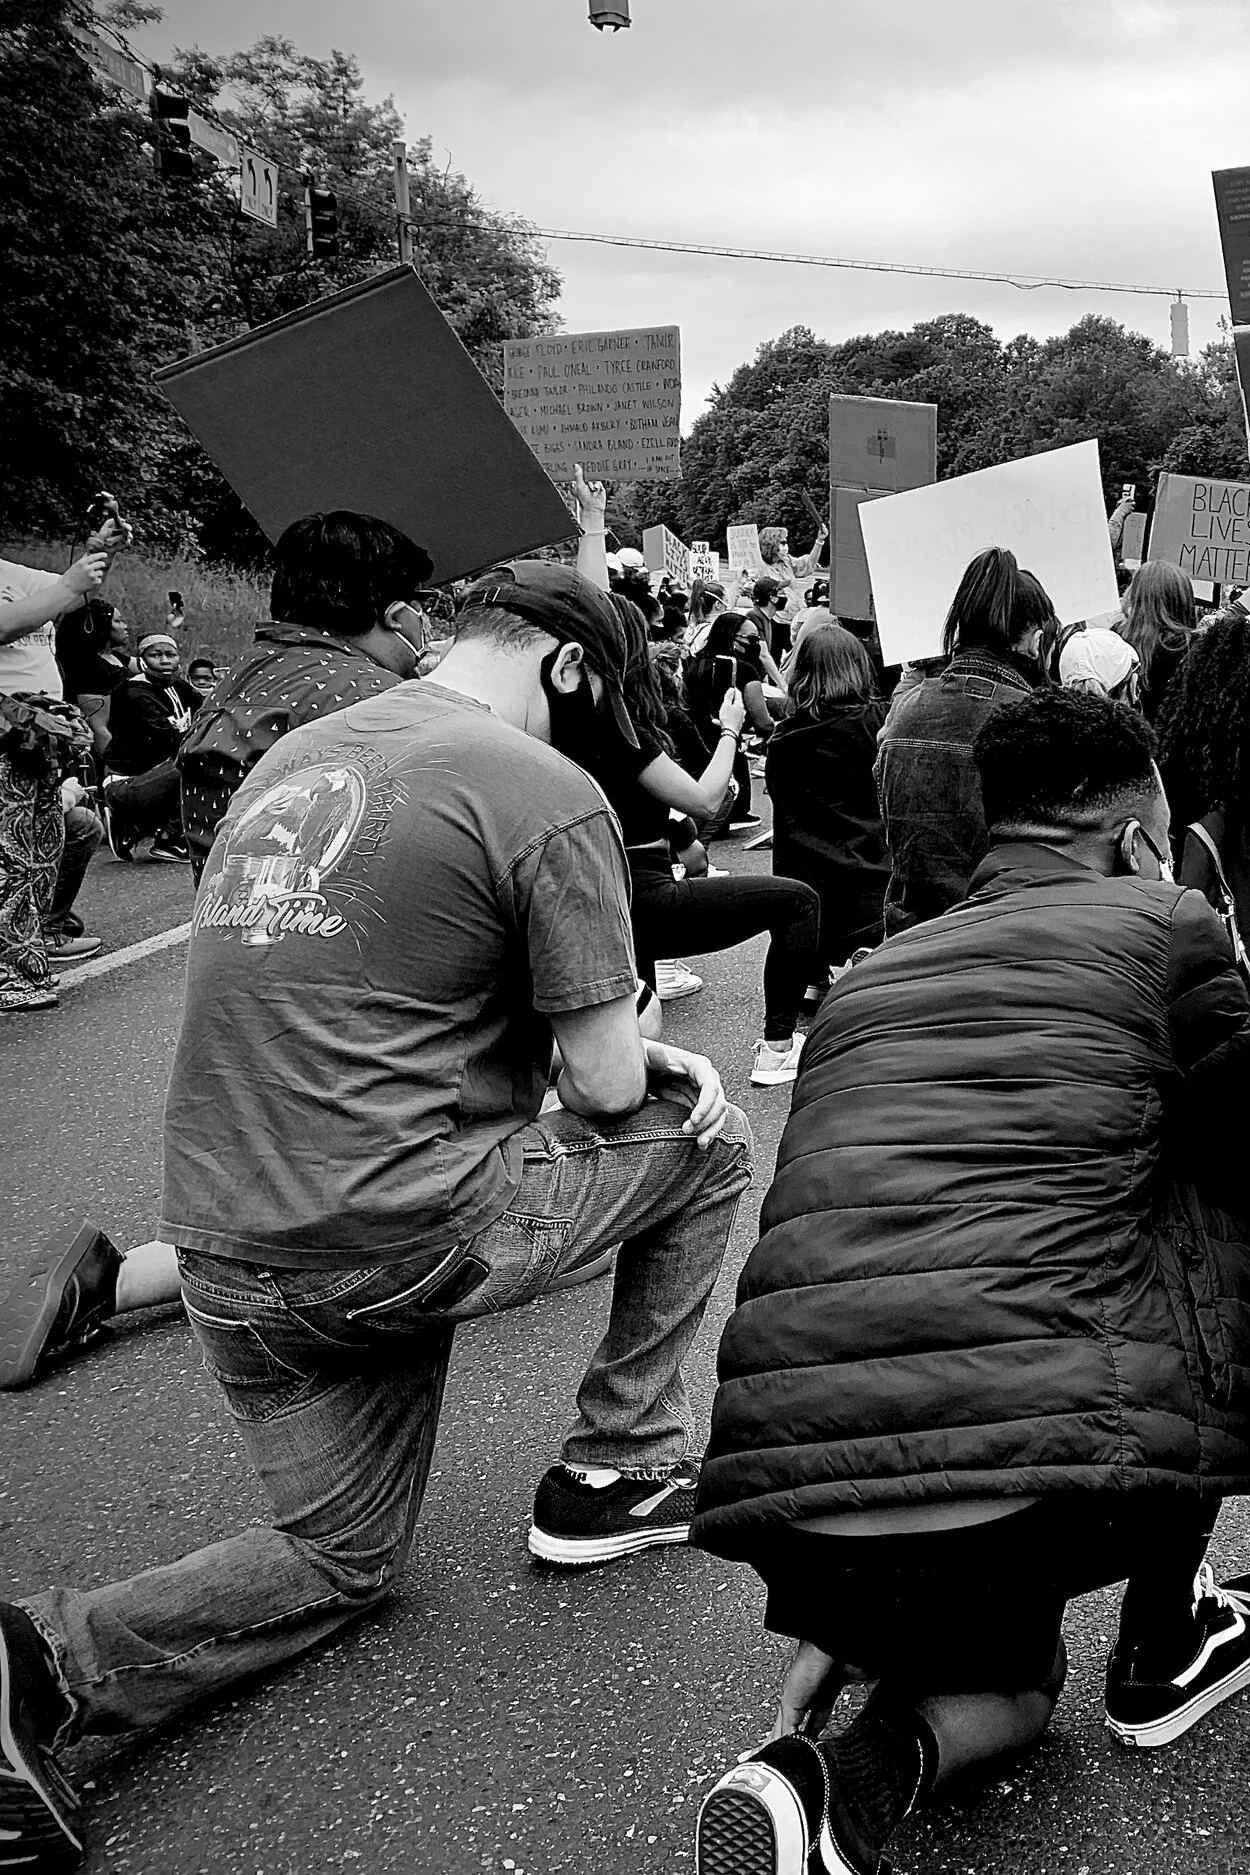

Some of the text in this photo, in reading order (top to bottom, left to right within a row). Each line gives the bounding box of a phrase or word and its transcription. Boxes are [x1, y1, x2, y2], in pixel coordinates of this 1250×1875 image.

[571, 340, 594, 354] ERIC
[614, 399, 638, 412] JANET
[642, 397, 675, 410] WILSON
[193, 890, 349, 938] Island Time
